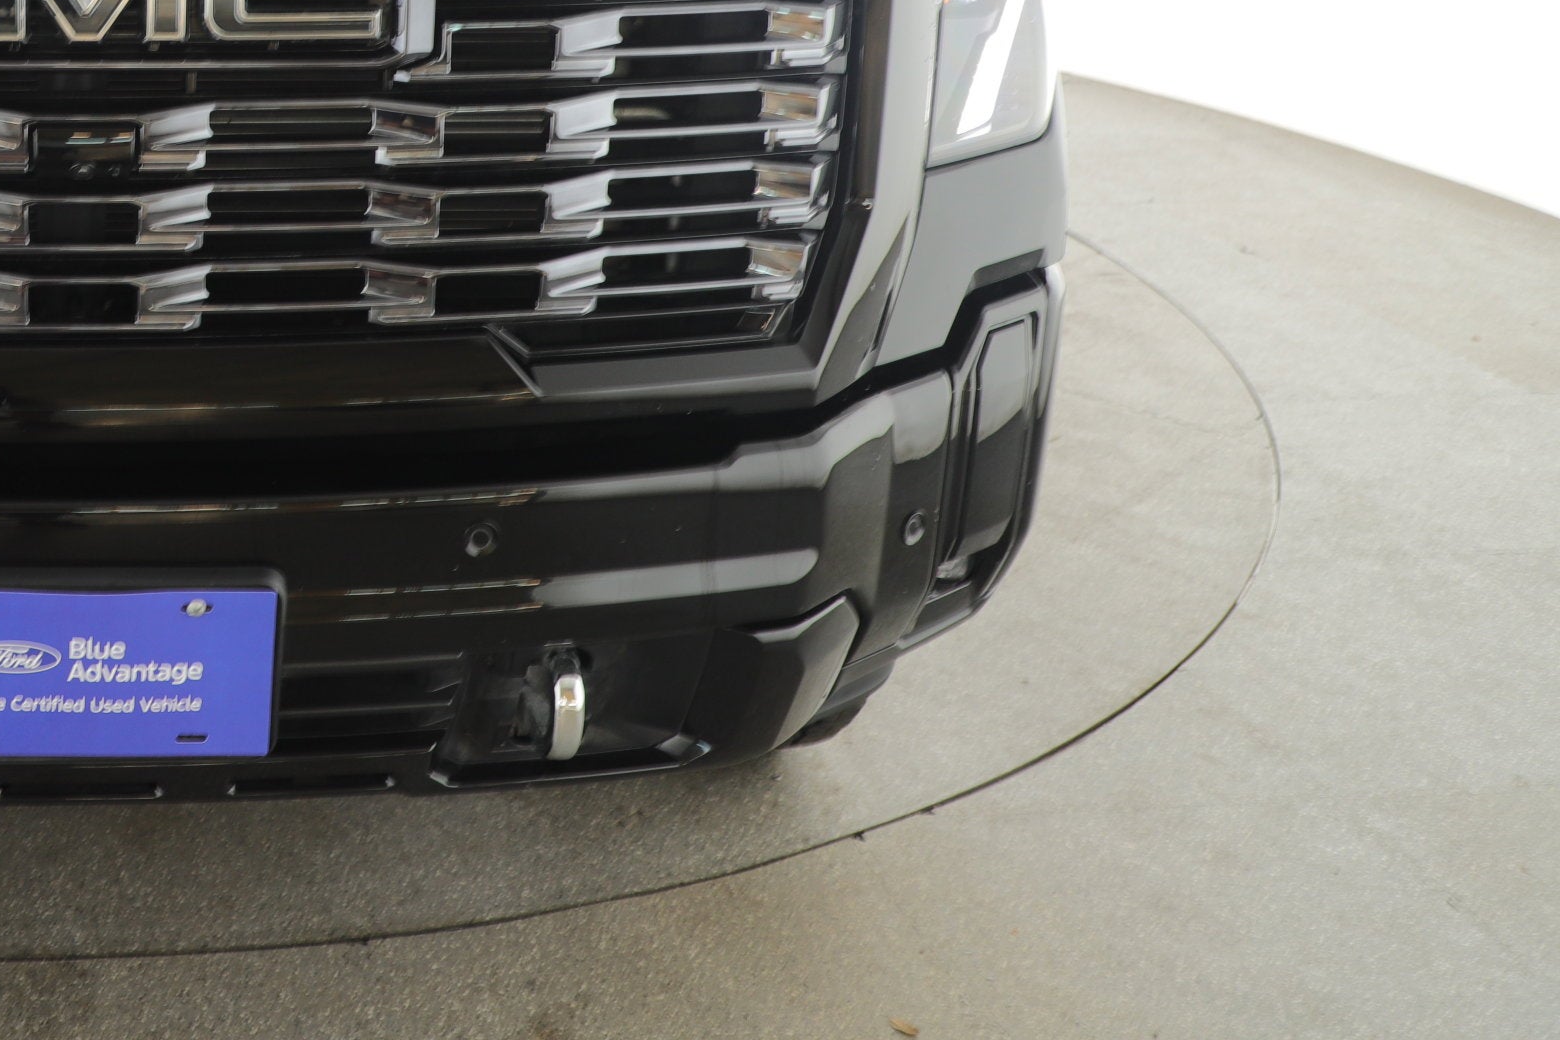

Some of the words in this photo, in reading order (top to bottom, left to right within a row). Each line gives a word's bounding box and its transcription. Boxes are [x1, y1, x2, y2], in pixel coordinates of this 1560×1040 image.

[68, 637, 127, 659] Blue
[67, 660, 203, 685] Advantage
[11, 694, 86, 714] Certified
[90, 696, 135, 714] Used
[140, 695, 202, 713] Vehicle
